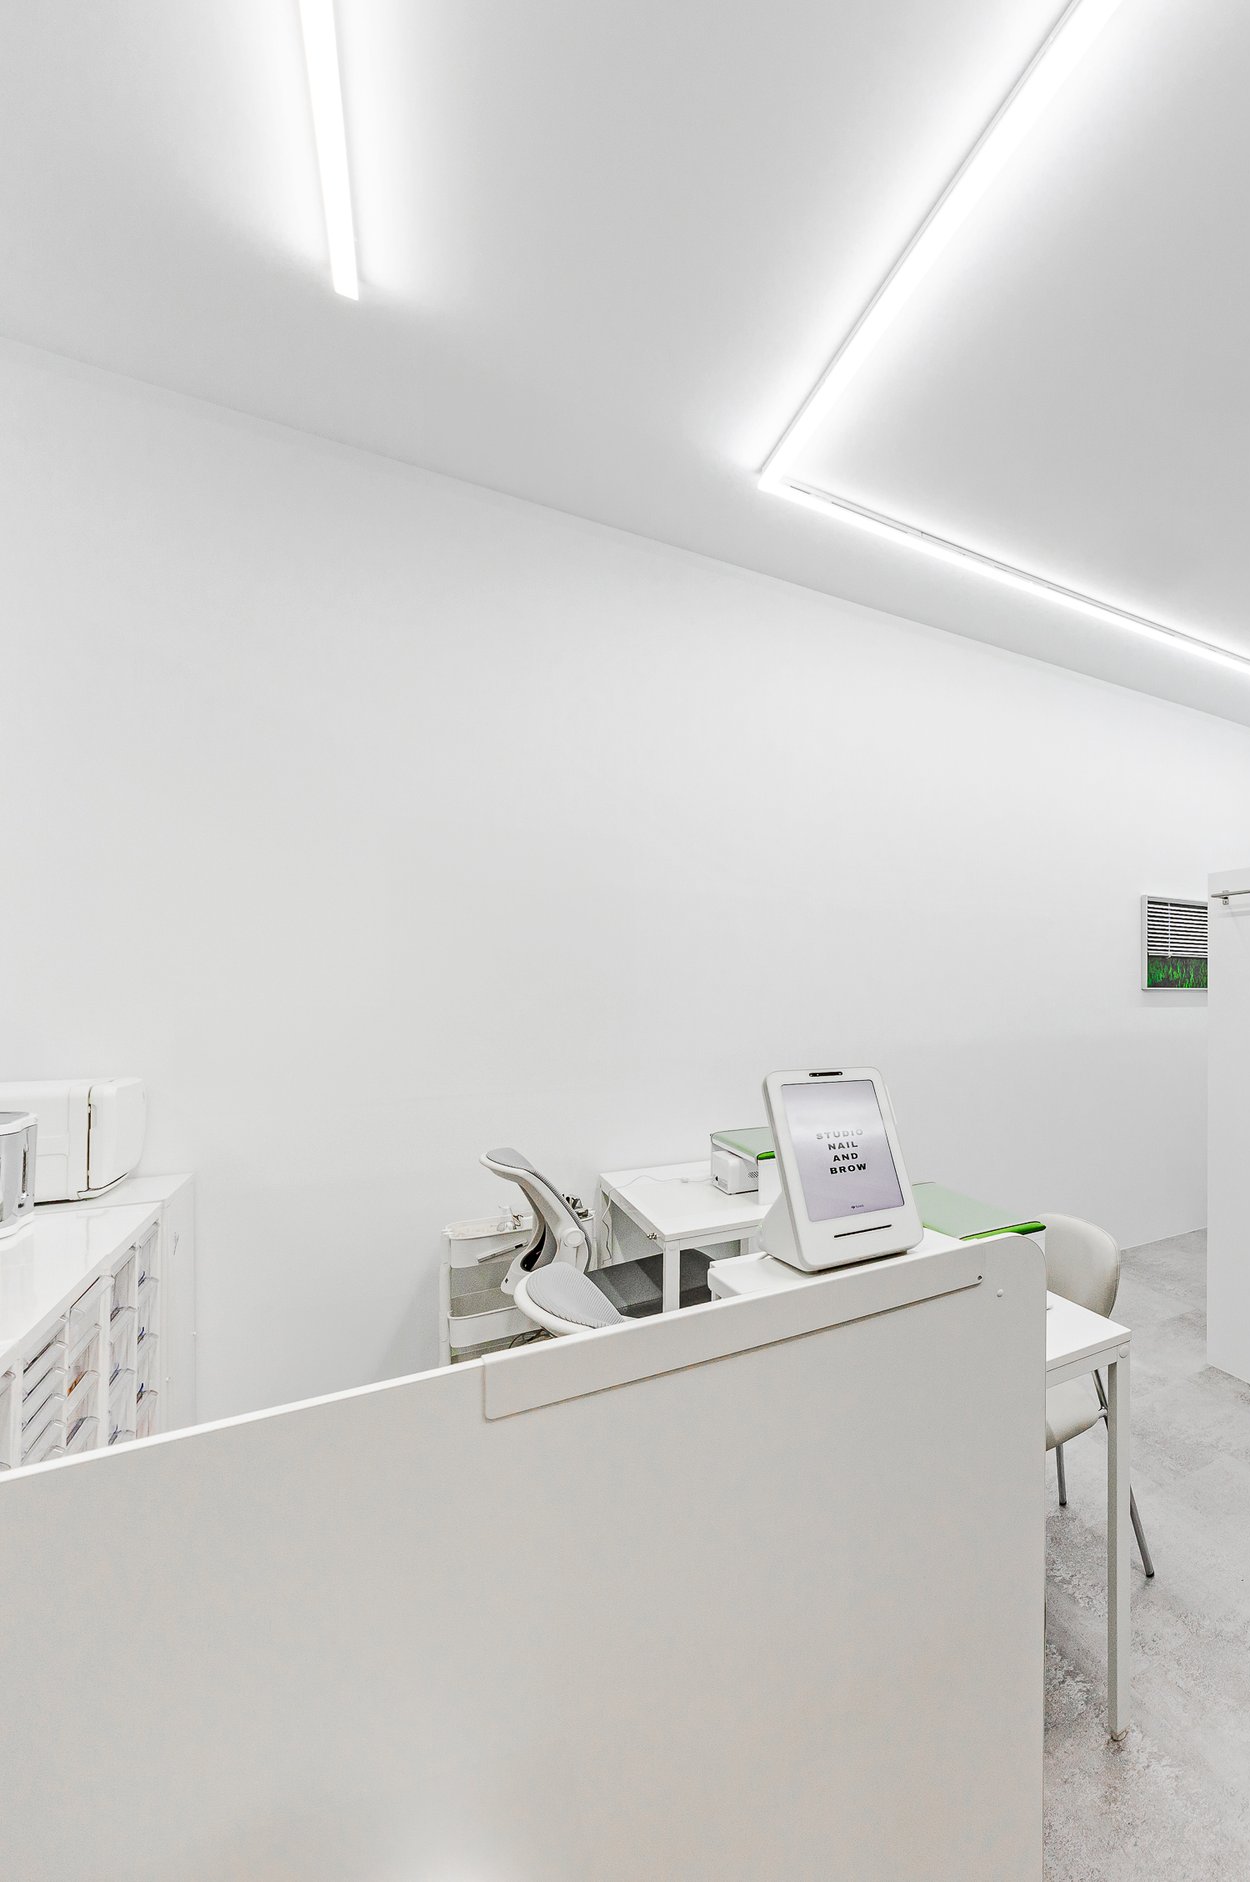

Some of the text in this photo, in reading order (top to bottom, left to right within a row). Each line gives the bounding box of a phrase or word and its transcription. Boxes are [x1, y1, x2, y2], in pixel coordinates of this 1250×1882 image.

[816, 1129, 863, 1139] STUDIO
[828, 1141, 858, 1150] NAIL
[833, 1153, 858, 1162] AND
[830, 1163, 866, 1174] BROW
